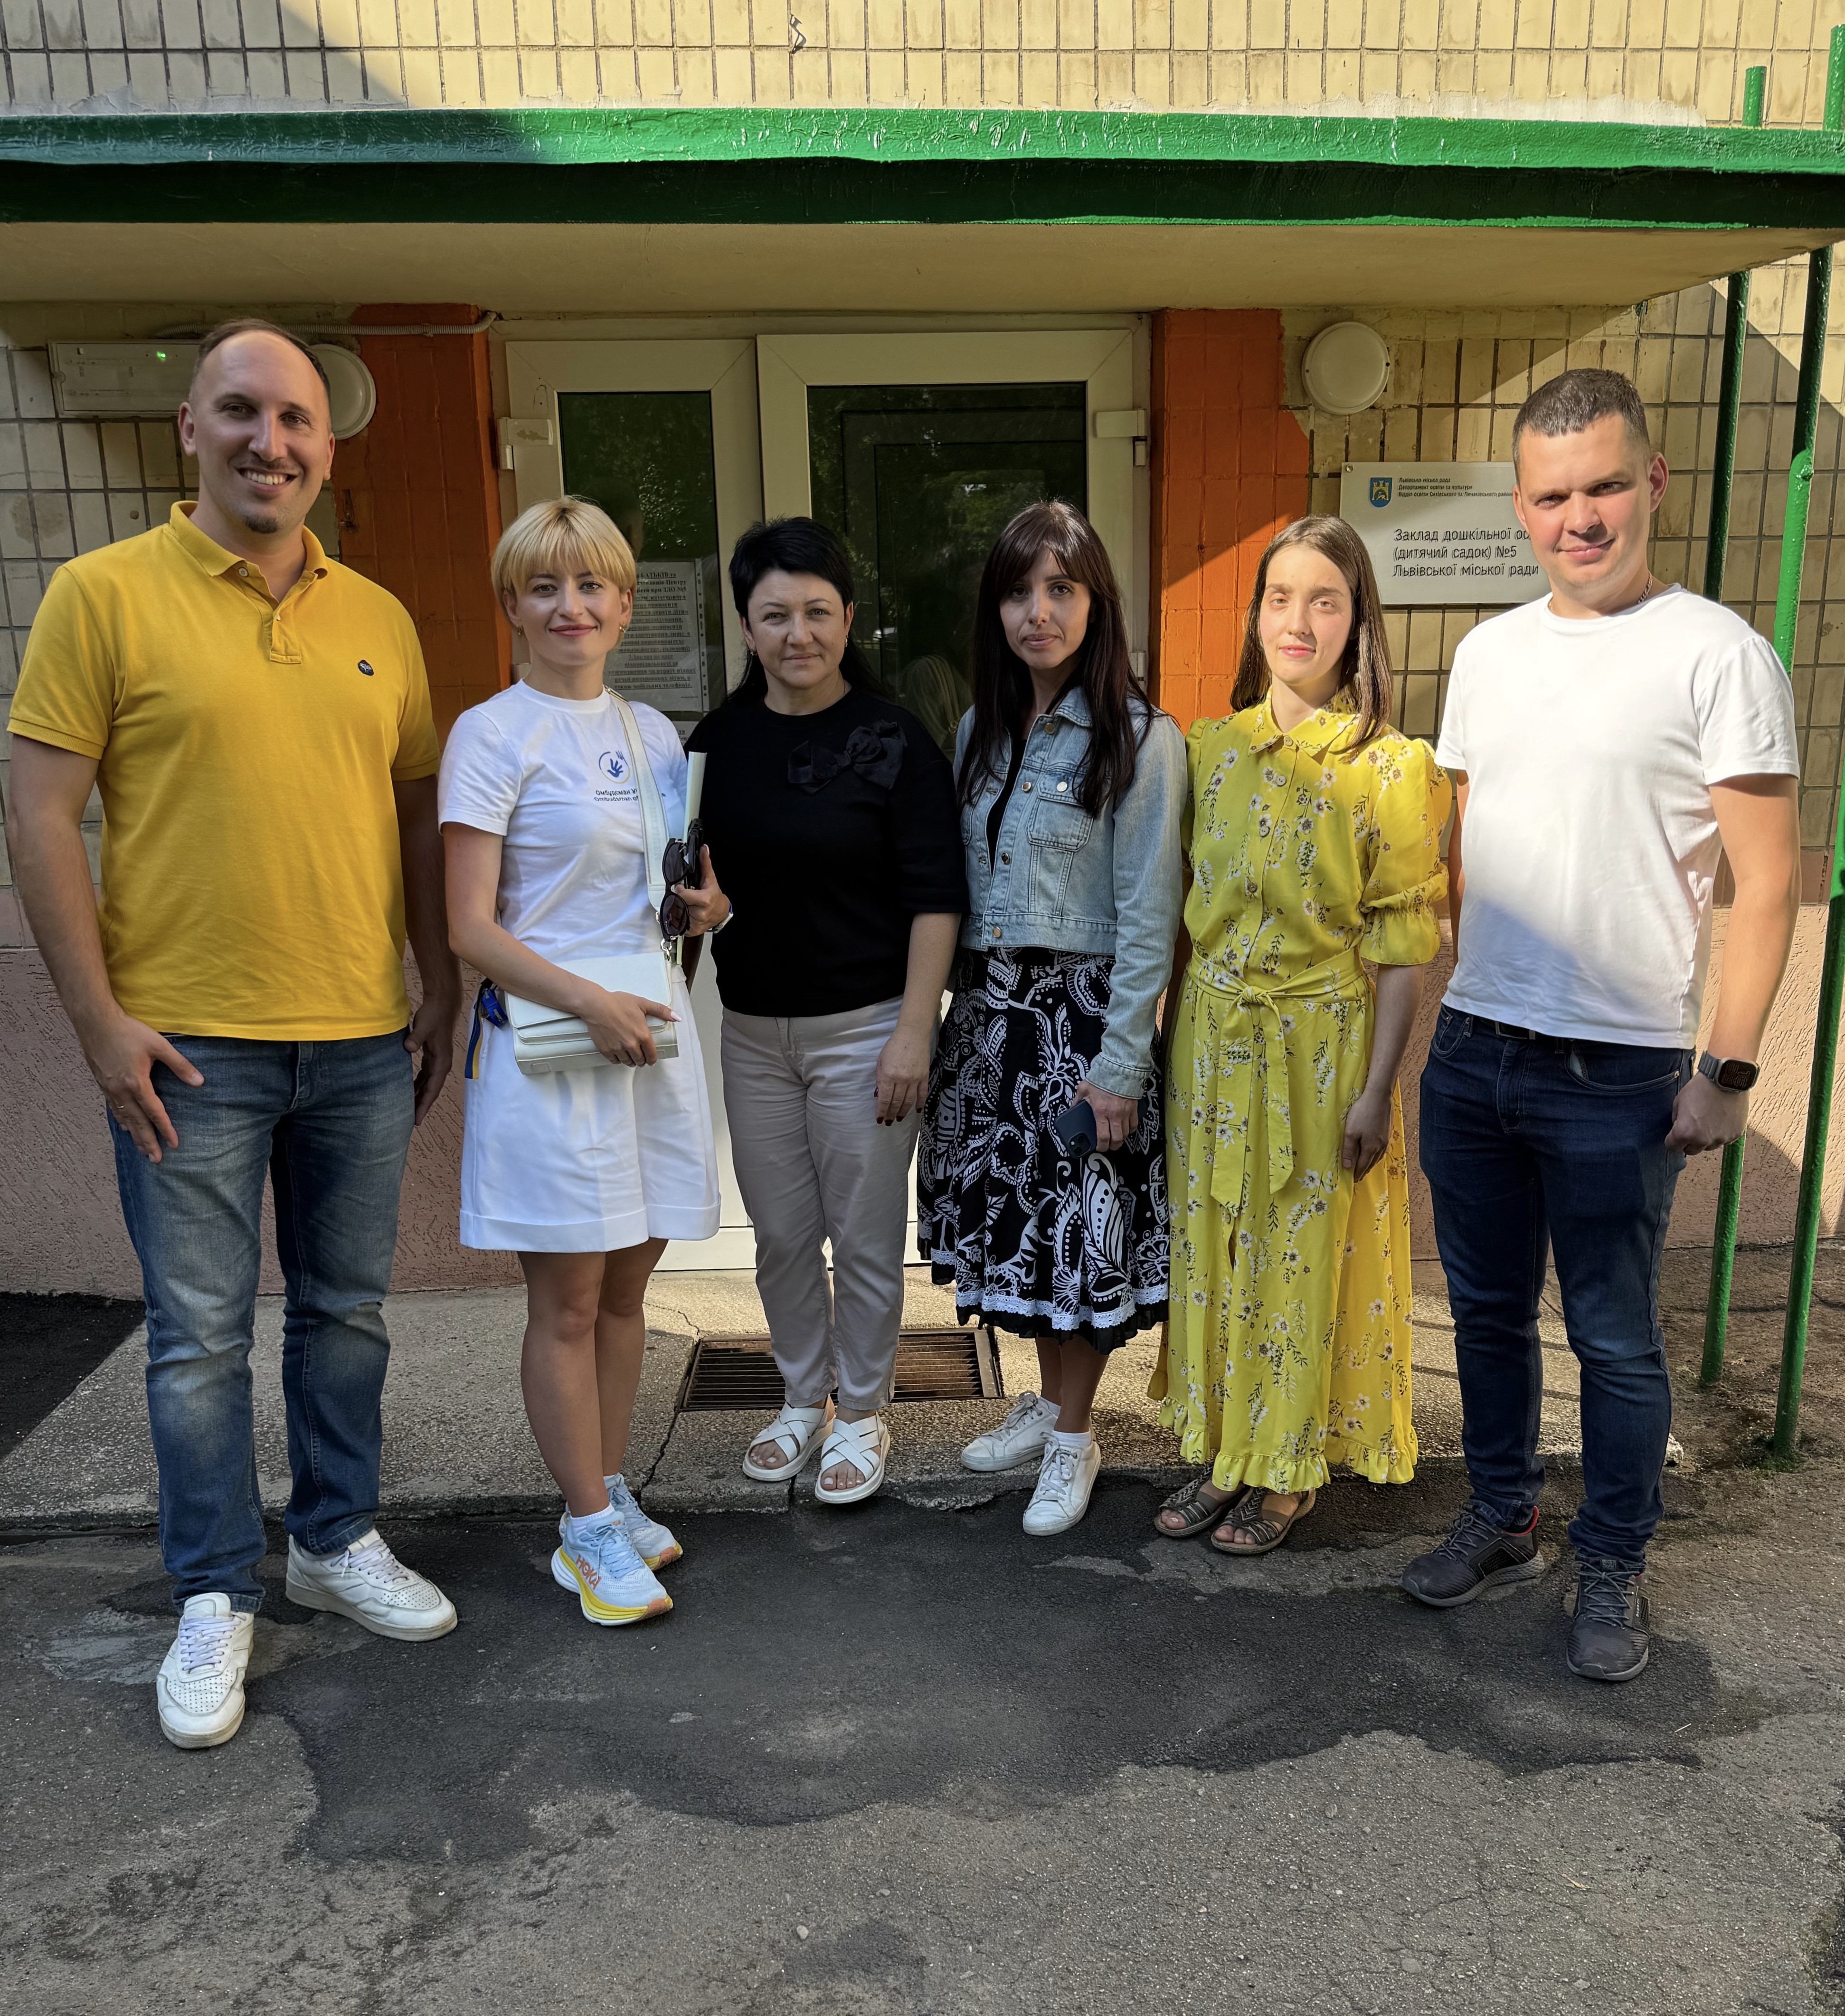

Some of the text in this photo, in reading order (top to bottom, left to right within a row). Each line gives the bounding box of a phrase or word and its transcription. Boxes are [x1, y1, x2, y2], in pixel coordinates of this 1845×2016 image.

[1394, 528, 1531, 542] Заклад дошкільної ос
[1393, 545, 1517, 561] (дитячий садок) №5
[1392, 563, 1539, 578] Львівської міської ради
